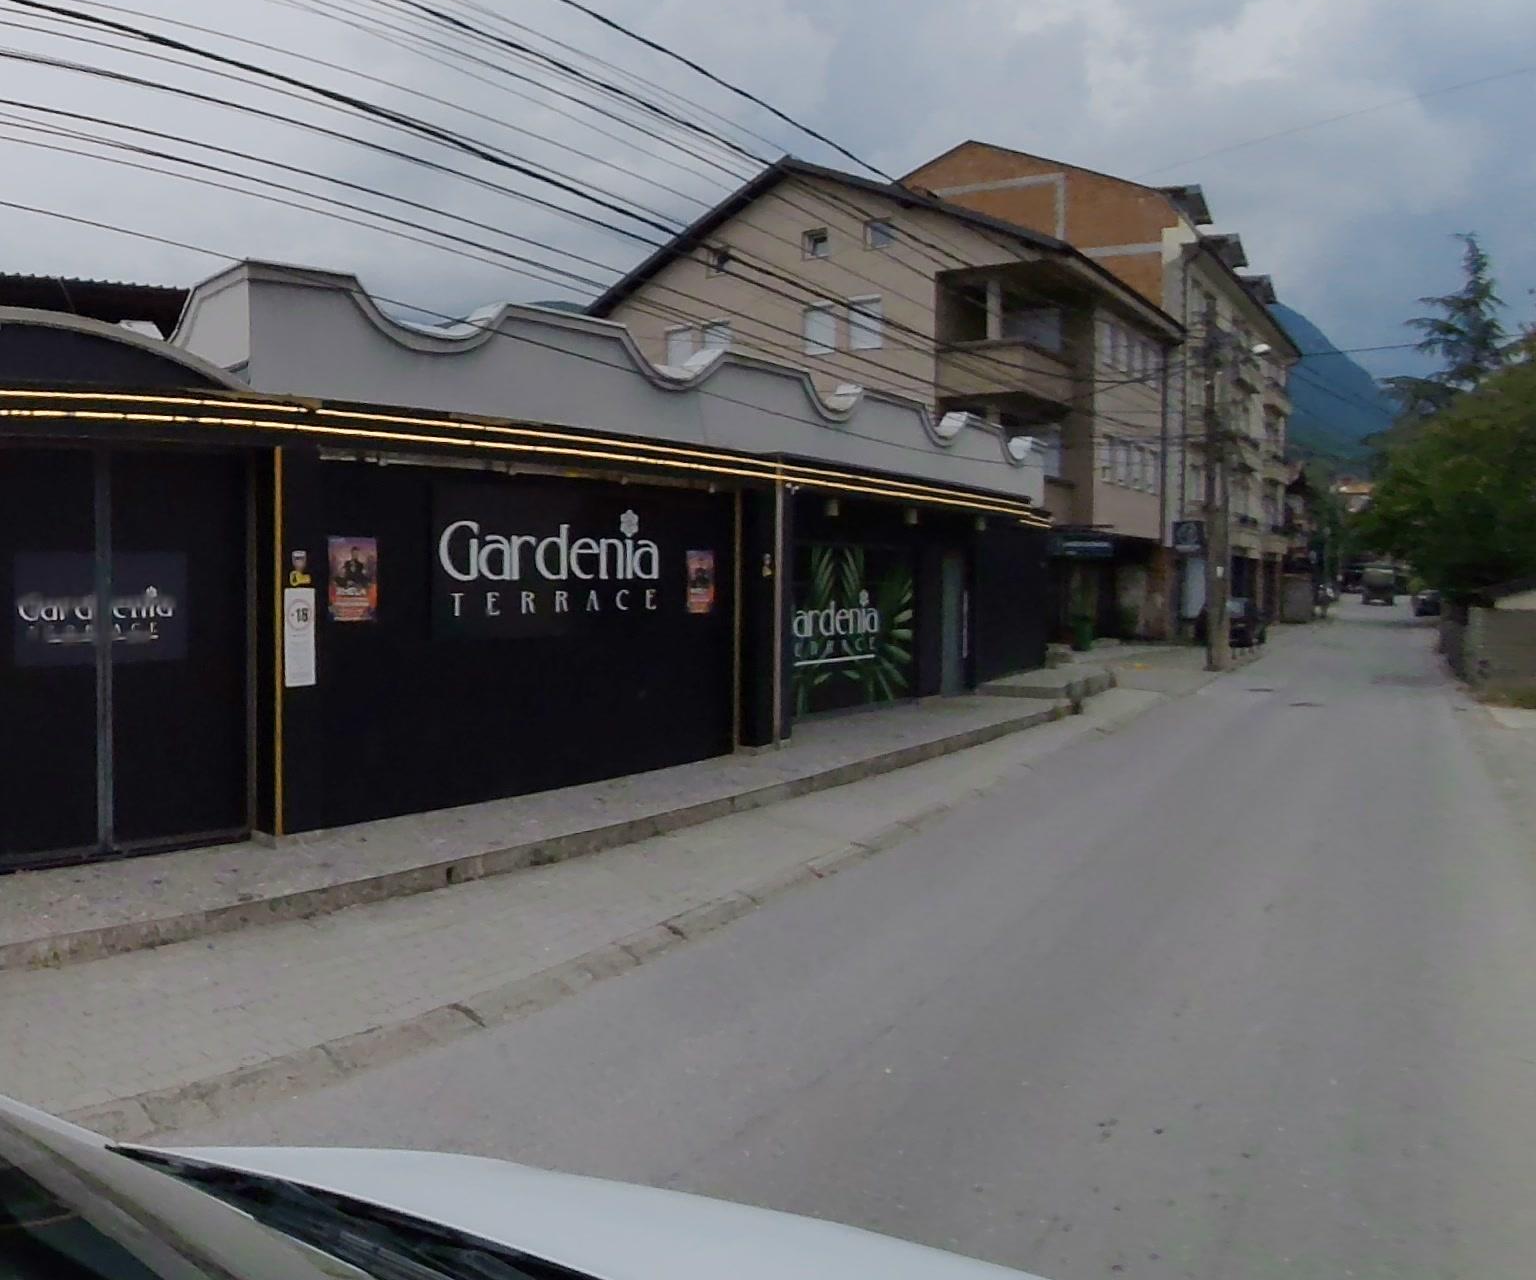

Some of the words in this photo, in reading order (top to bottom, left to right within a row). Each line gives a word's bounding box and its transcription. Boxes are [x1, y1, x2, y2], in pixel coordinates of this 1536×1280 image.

[439, 509, 660, 582] Gardenia
[450, 588, 658, 617] TERRACE
[793, 590, 879, 638] ardenia
